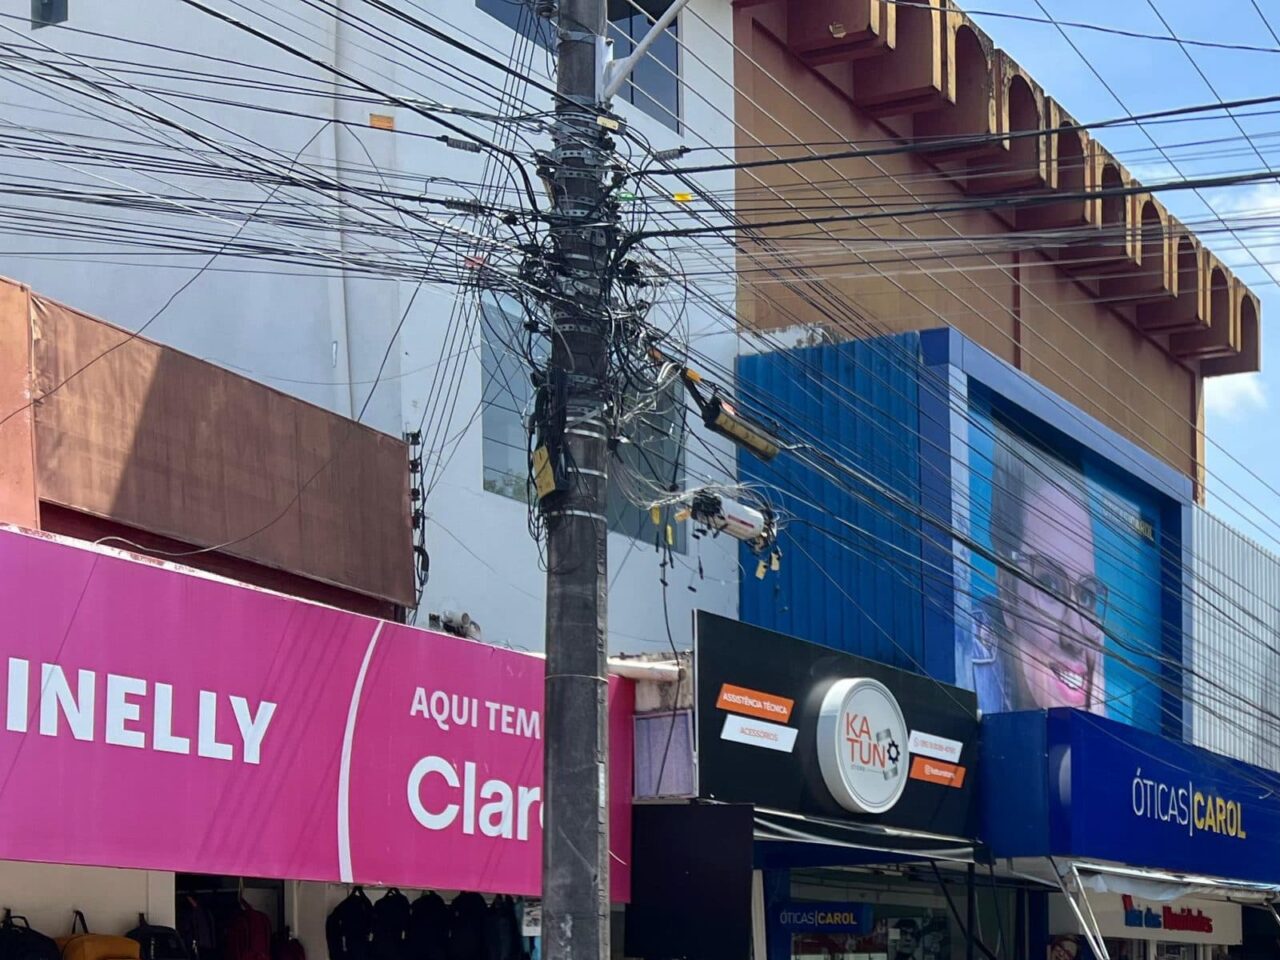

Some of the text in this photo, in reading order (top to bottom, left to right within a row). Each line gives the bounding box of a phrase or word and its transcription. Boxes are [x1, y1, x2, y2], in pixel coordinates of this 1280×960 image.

[7, 657, 277, 764] INELLY
[410, 686, 541, 740] AQUI TEM
[845, 712, 873, 741] KA
[407, 755, 544, 841] Clar
[1193, 791, 1247, 839] CAROL
